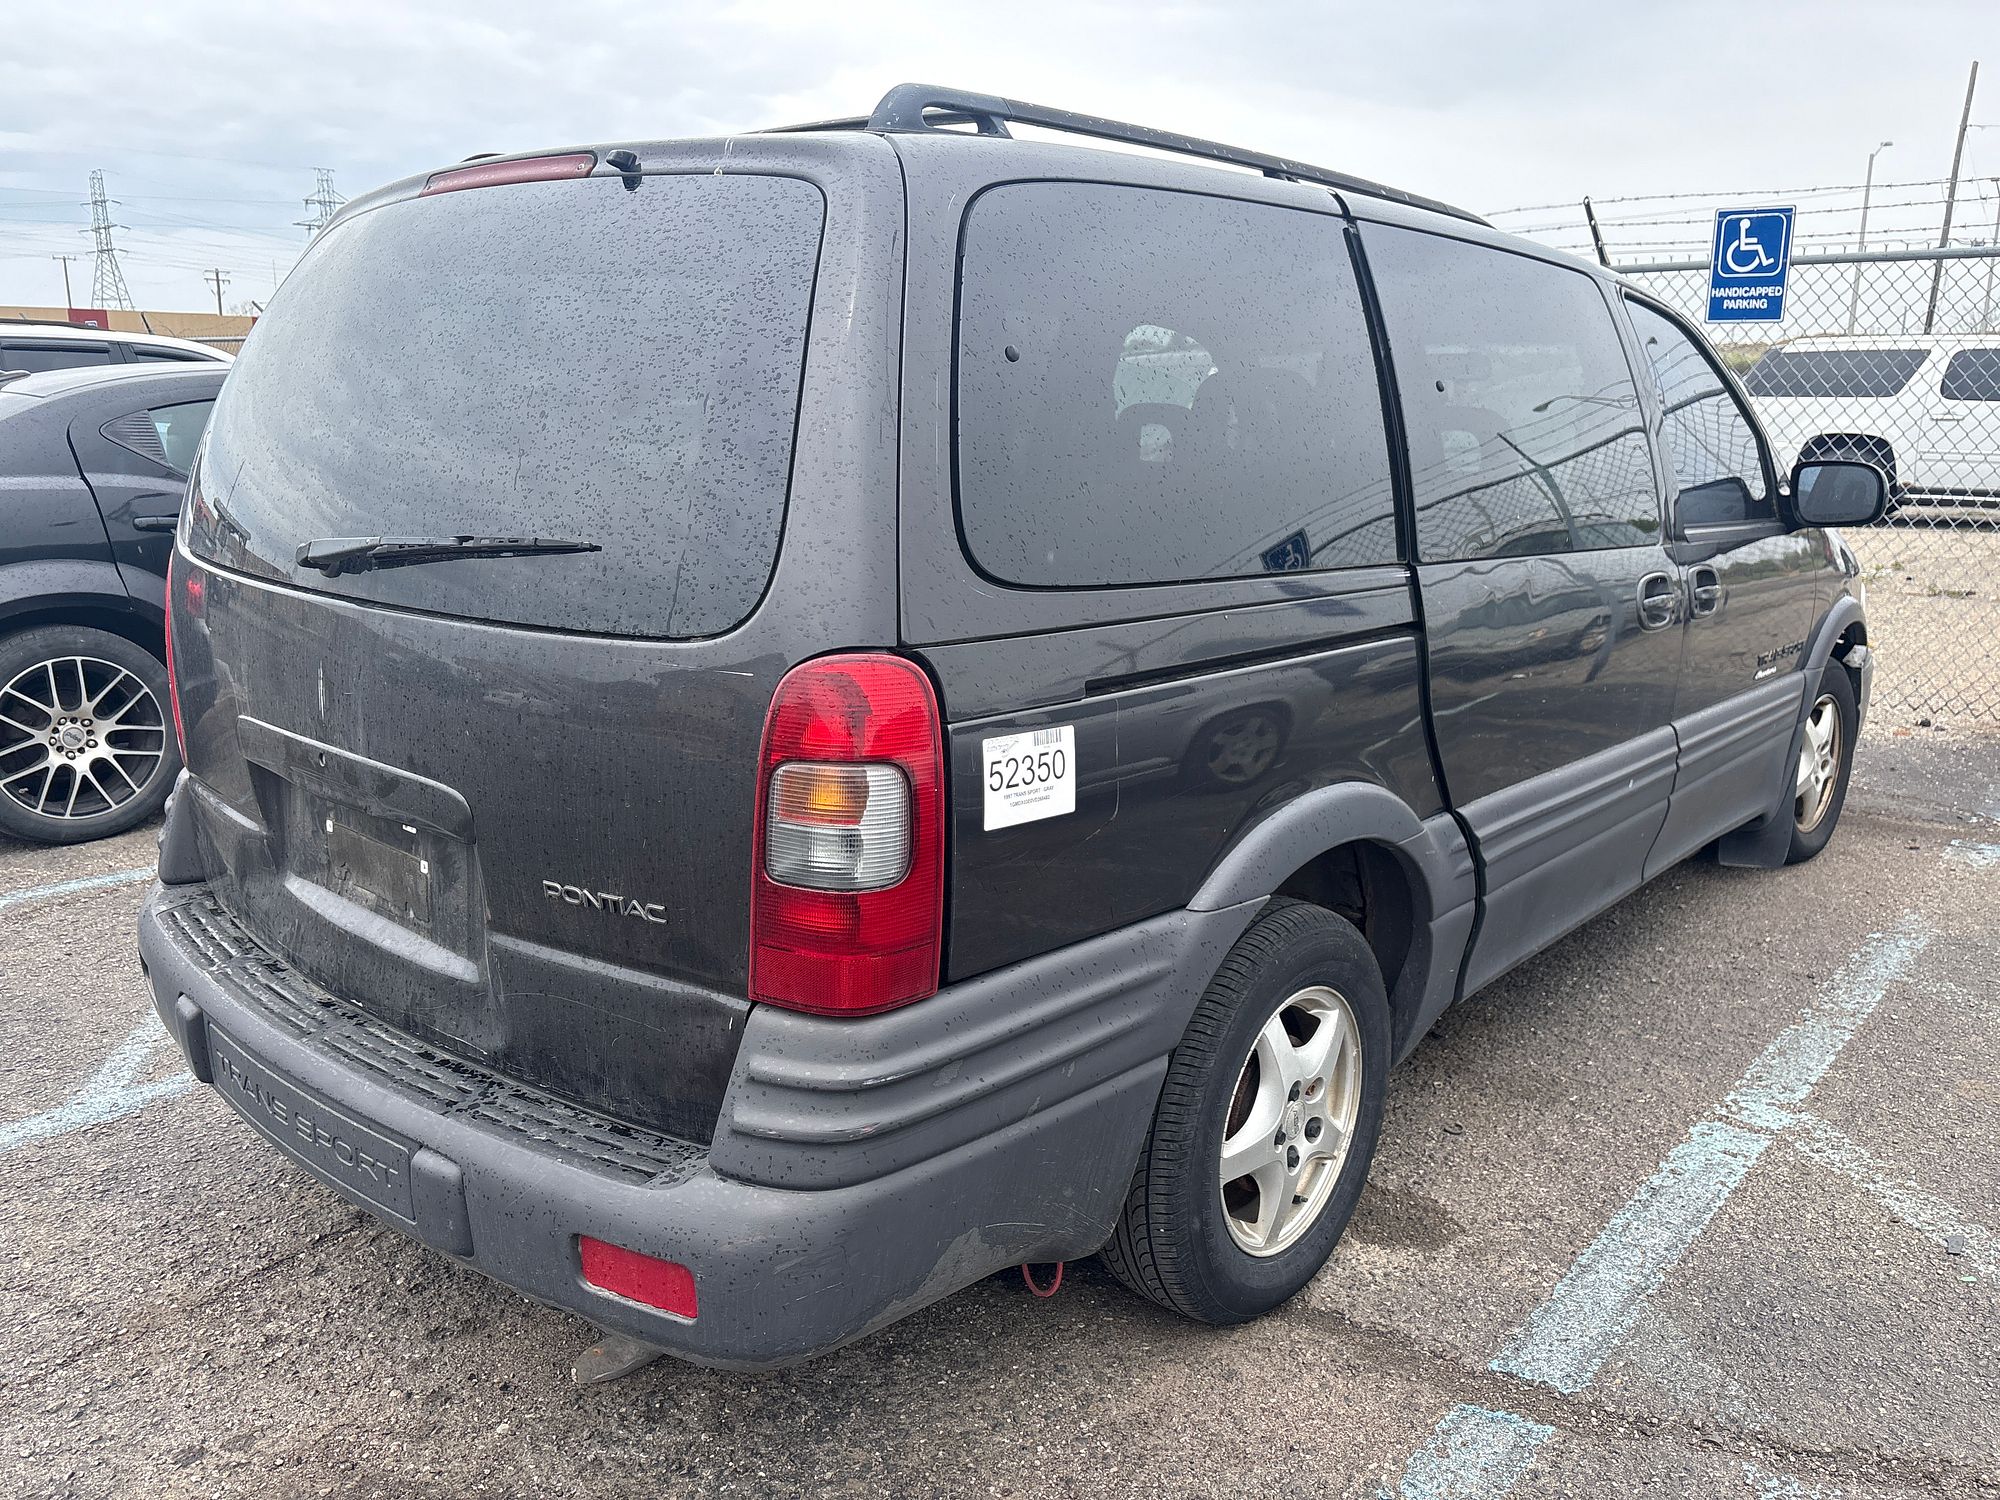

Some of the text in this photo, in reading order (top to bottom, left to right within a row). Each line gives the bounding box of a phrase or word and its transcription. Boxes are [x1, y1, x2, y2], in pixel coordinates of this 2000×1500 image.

[1711, 286, 1783, 298] HANDICAPPED
[1723, 299, 1768, 309] PARKING
[989, 749, 1065, 792] 52350
[542, 879, 668, 924] PONTIAC
[216, 1048, 399, 1188] TRANS SPORT
